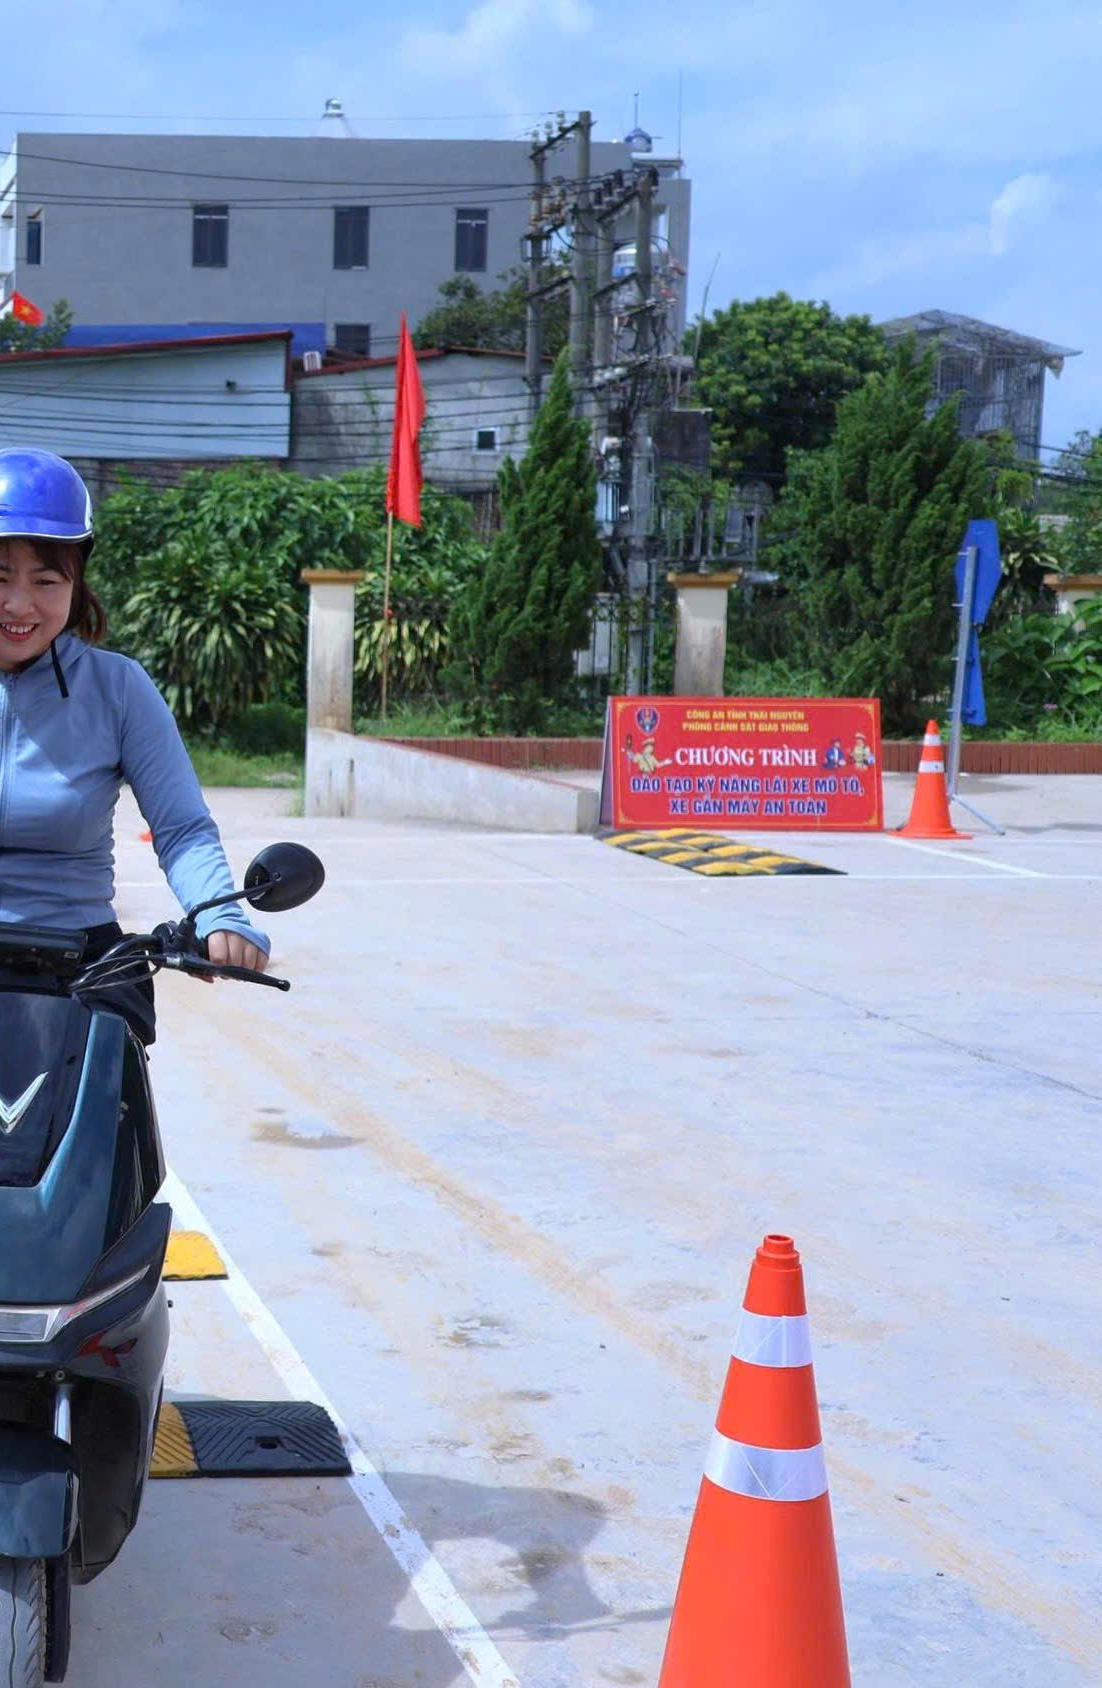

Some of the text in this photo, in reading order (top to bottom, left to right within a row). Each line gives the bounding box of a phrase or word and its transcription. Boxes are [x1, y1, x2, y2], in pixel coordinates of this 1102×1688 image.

[713, 710, 725, 720] AN
[675, 744, 817, 766] CHƯƠNG TRÌNH
[631, 774, 661, 793] ĐÀO
[666, 776, 692, 796] TẠO
[719, 774, 761, 793] NĂNG
[792, 777, 809, 793] XE
[814, 775, 839, 793] MÔ
[670, 799, 687, 814] XE
[727, 797, 760, 814] MÁY
[764, 800, 785, 814] AN
[789, 797, 827, 815] TOÀN
